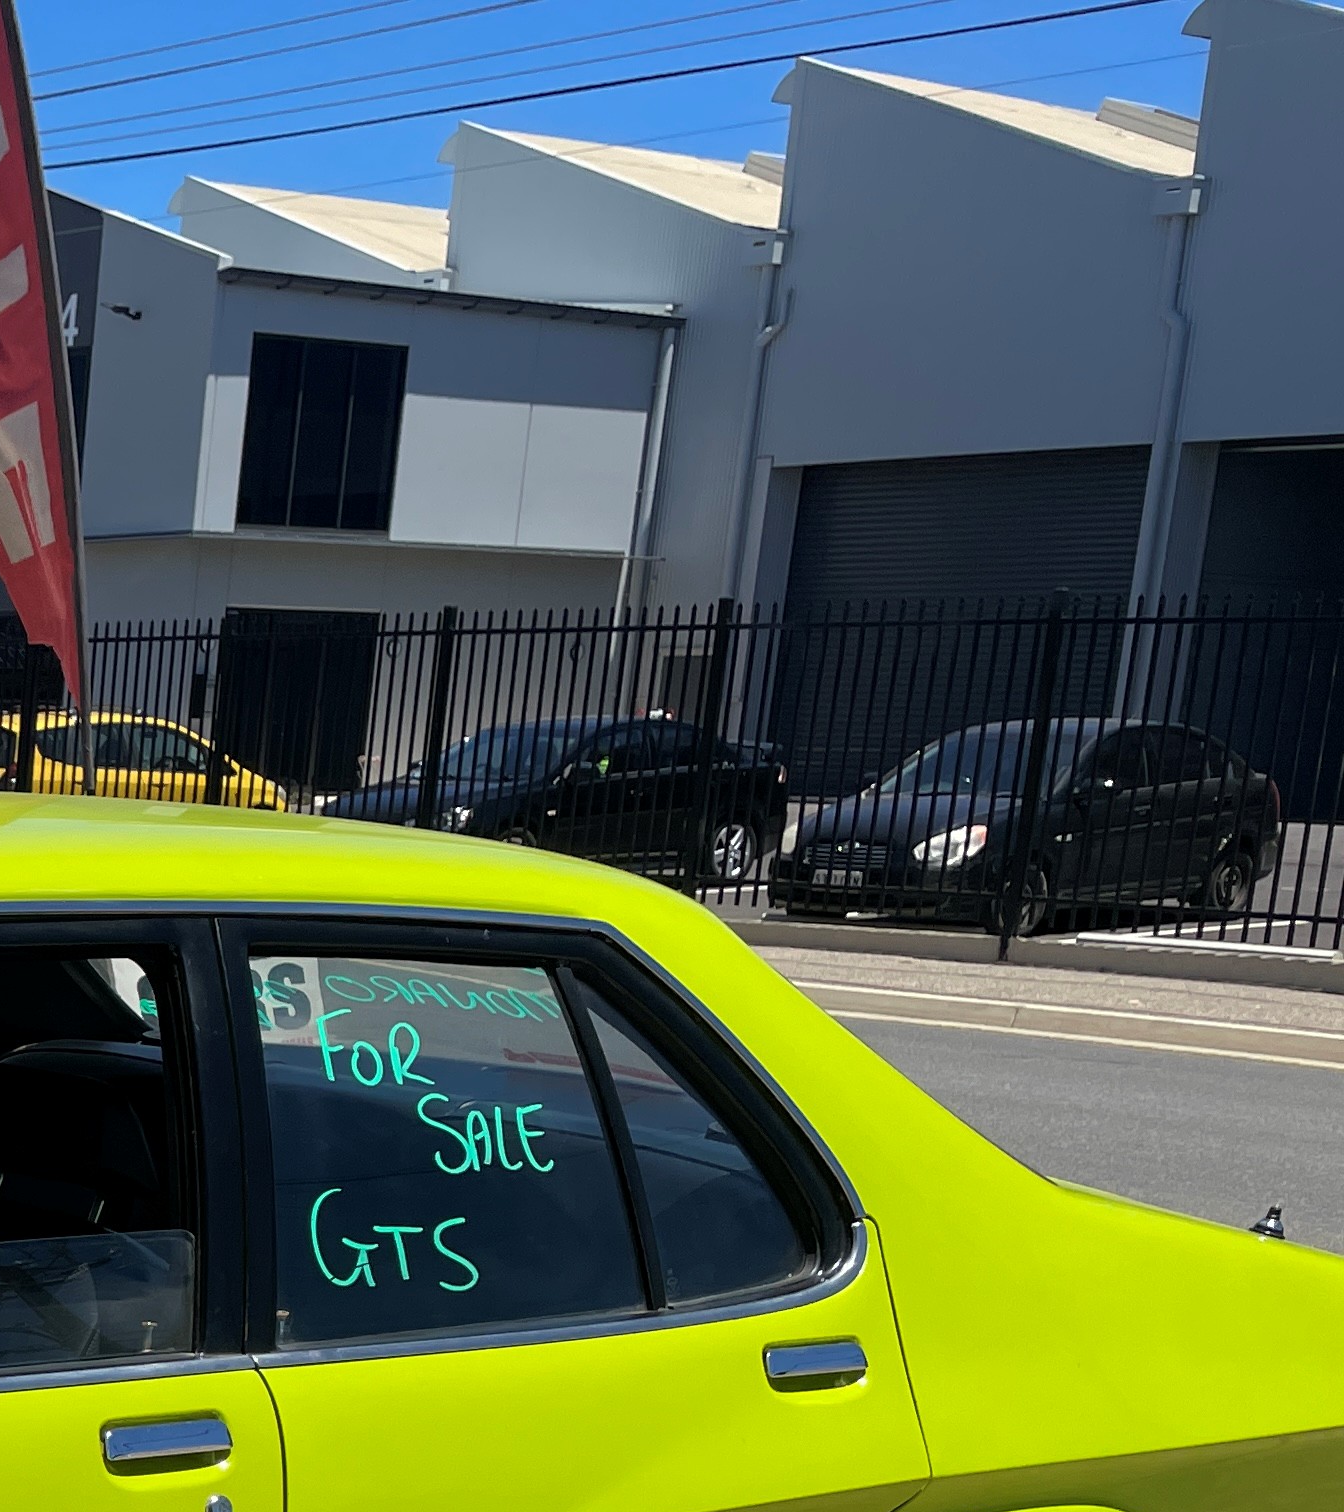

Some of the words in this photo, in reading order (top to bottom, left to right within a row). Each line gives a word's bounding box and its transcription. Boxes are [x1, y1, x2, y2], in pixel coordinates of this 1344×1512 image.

[316, 1008, 436, 1087] FOR
[417, 1092, 554, 1175] SALE
[311, 1187, 480, 1292] GTS
